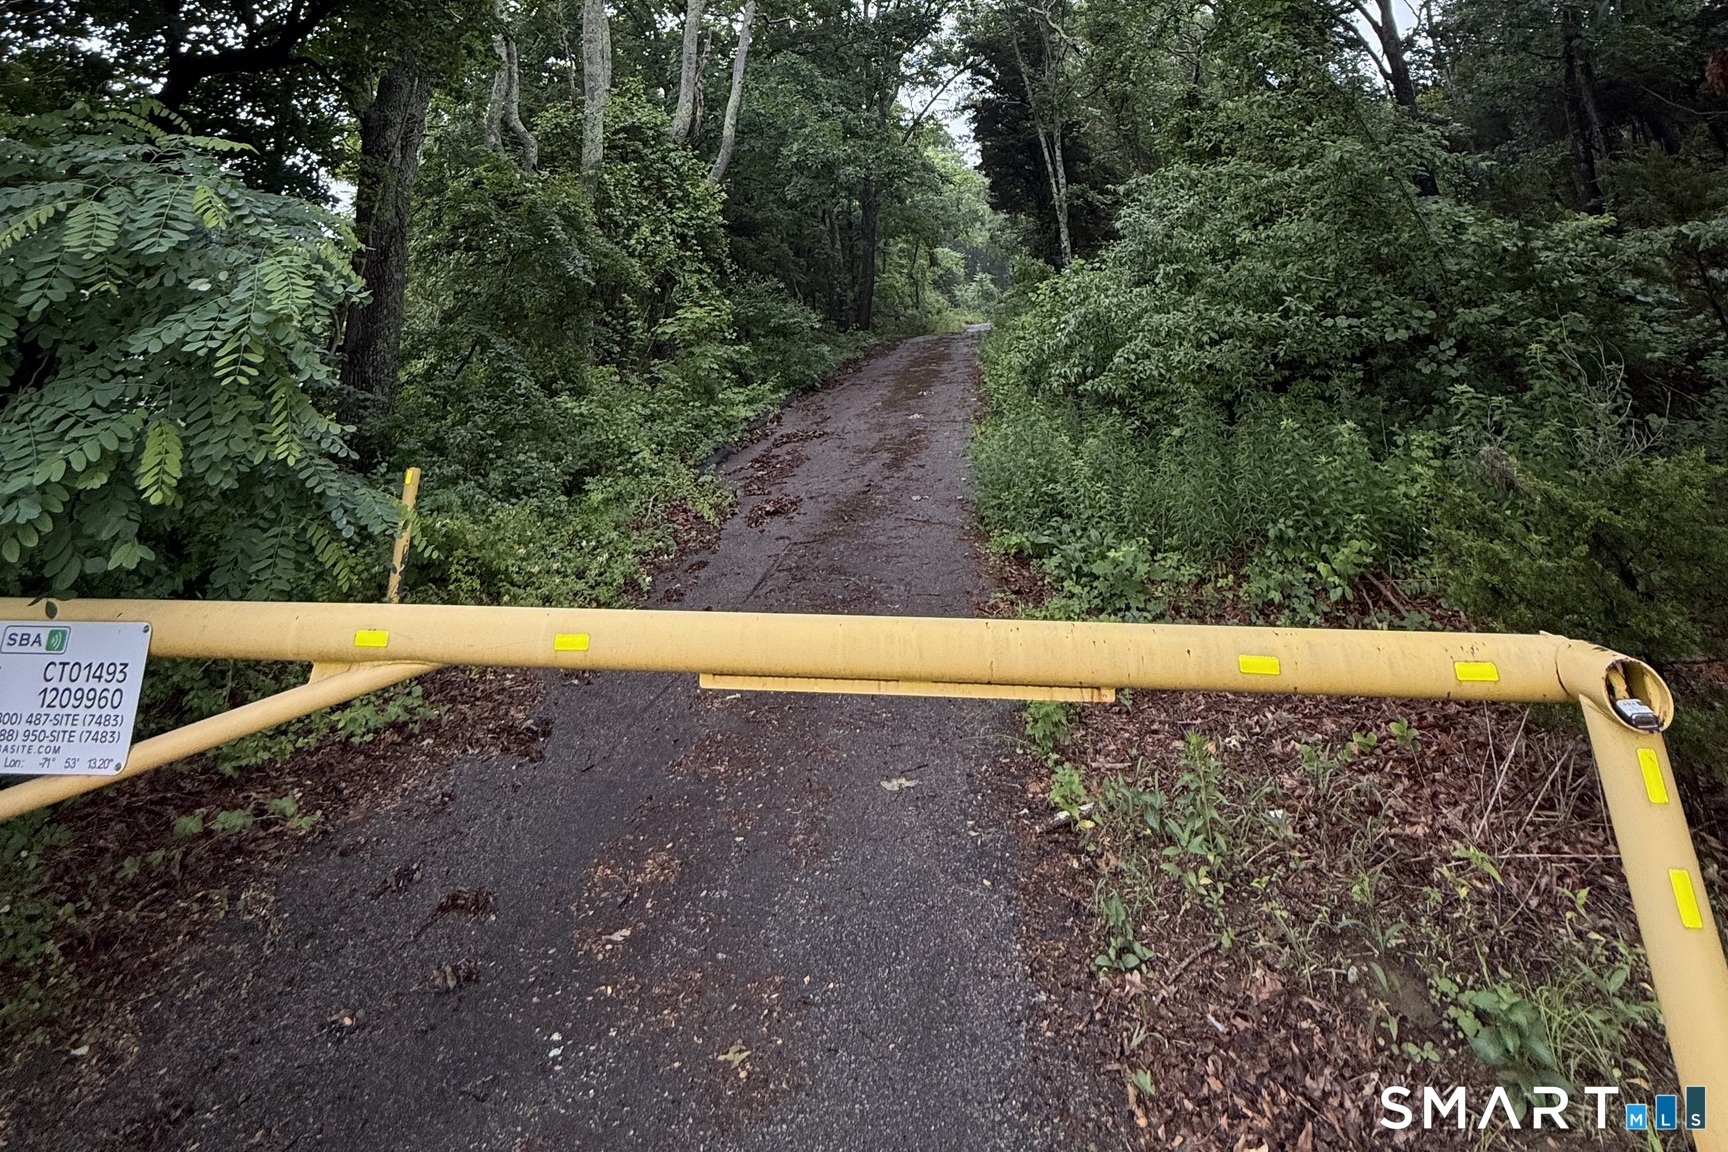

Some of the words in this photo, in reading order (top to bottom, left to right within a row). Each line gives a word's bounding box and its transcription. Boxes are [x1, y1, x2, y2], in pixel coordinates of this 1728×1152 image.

[7, 633, 42, 647] SBA
[43, 661, 129, 683] CT01493
[38, 687, 123, 709] 1209960
[0, 712, 22, 726] 00)
[25, 713, 80, 727] 487-SITE
[82, 714, 124, 727] (7483)
[22, 730, 76, 743] 950-SITE
[79, 730, 121, 744] (7483)
[0, 744, 61, 755] ASITE.COM
[4, 757, 25, 768] Lon:
